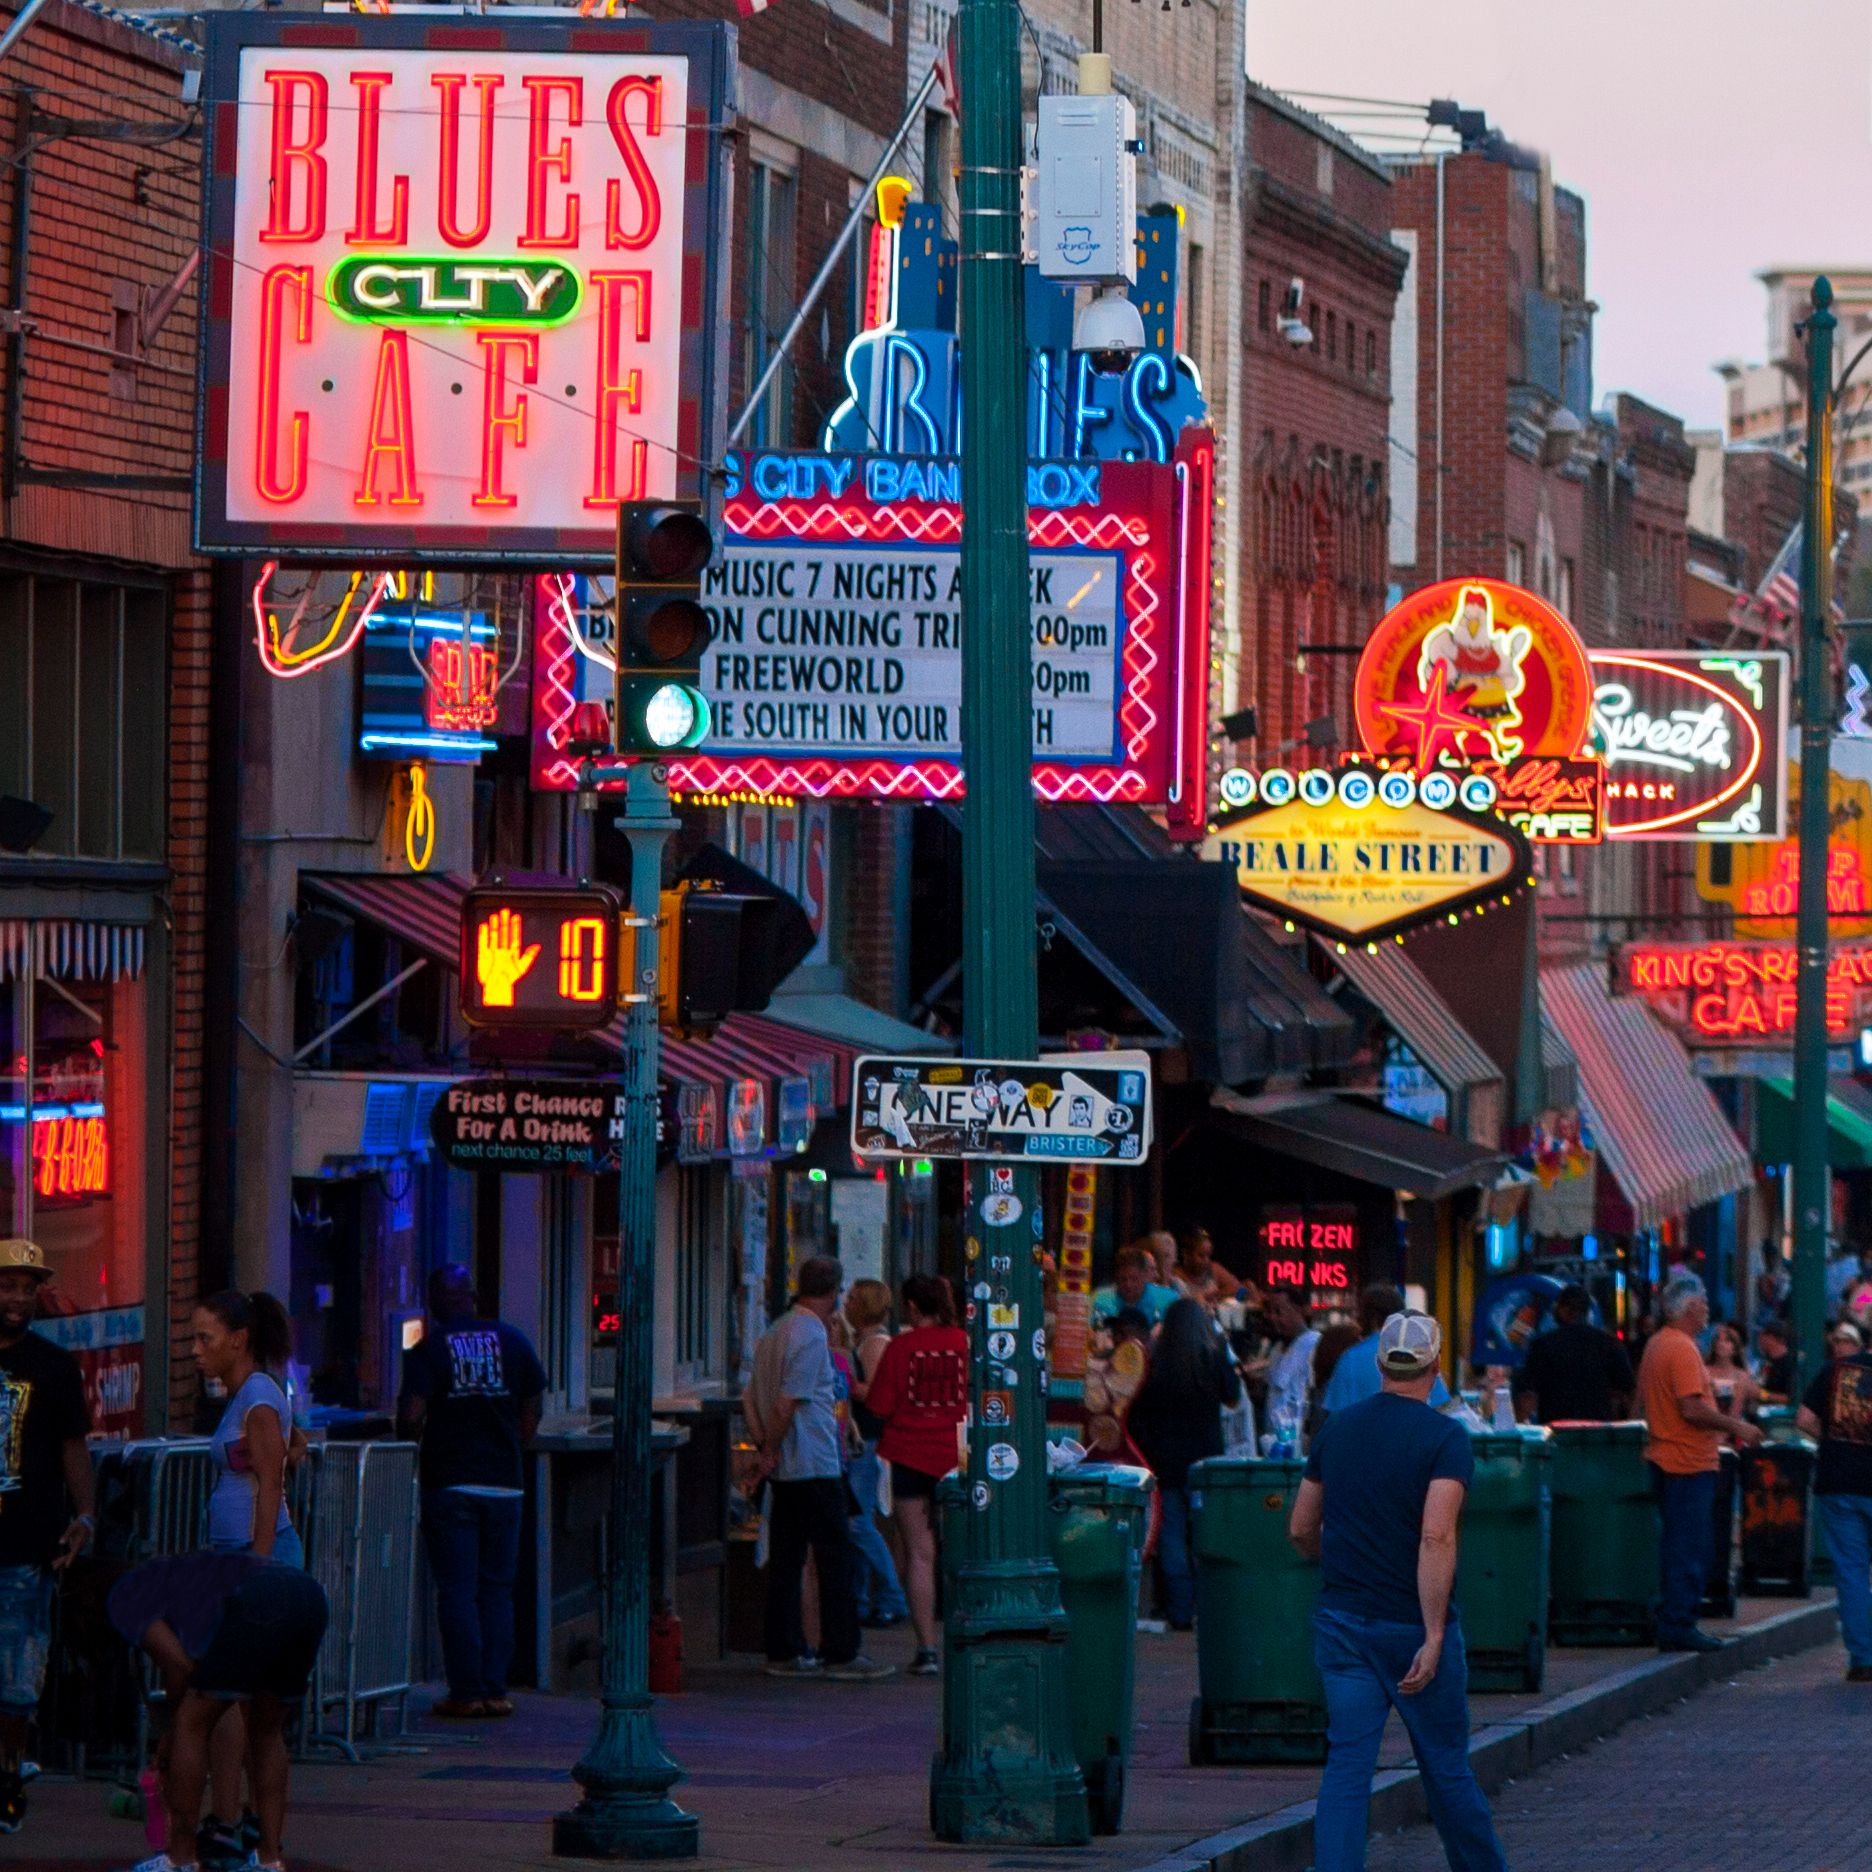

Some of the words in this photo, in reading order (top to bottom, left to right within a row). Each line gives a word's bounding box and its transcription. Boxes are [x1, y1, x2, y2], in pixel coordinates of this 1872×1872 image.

[259, 70, 664, 250] BLUES
[353, 263, 567, 313] CITY
[256, 264, 654, 510] CAFE
[754, 455, 854, 499] CITY
[865, 459, 962, 504] BAN
[704, 559, 797, 600] MUSIC
[806, 561, 824, 596] 7
[833, 562, 938, 602] NIGHTS
[756, 608, 901, 648] CUNNING
[914, 612, 961, 649] TRI
[715, 653, 906, 695] FREEWORLD
[743, 702, 828, 741] SOUTH
[839, 703, 868, 741] IN
[876, 704, 948, 743] YOUR
[1593, 683, 1732, 771] Sweets
[1219, 841, 1338, 872] BEALE
[1354, 843, 1496, 873] STREET
[558, 917, 605, 1001] 10
[1632, 947, 1749, 986] KING'S
[448, 1089, 508, 1114] First
[513, 1091, 604, 1118] Chance
[456, 1116, 497, 1141] For
[499, 1118, 517, 1141] A
[523, 1118, 595, 1144] Drink
[1029, 1136, 1097, 1153] BRISTER
[451, 1142, 484, 1160] next
[486, 1142, 540, 1161] chance
[542, 1145, 563, 1163] 25
[565, 1145, 594, 1164] feet
[598, 1313, 622, 1332] 25
[453, 1335, 494, 1358] BLUES
